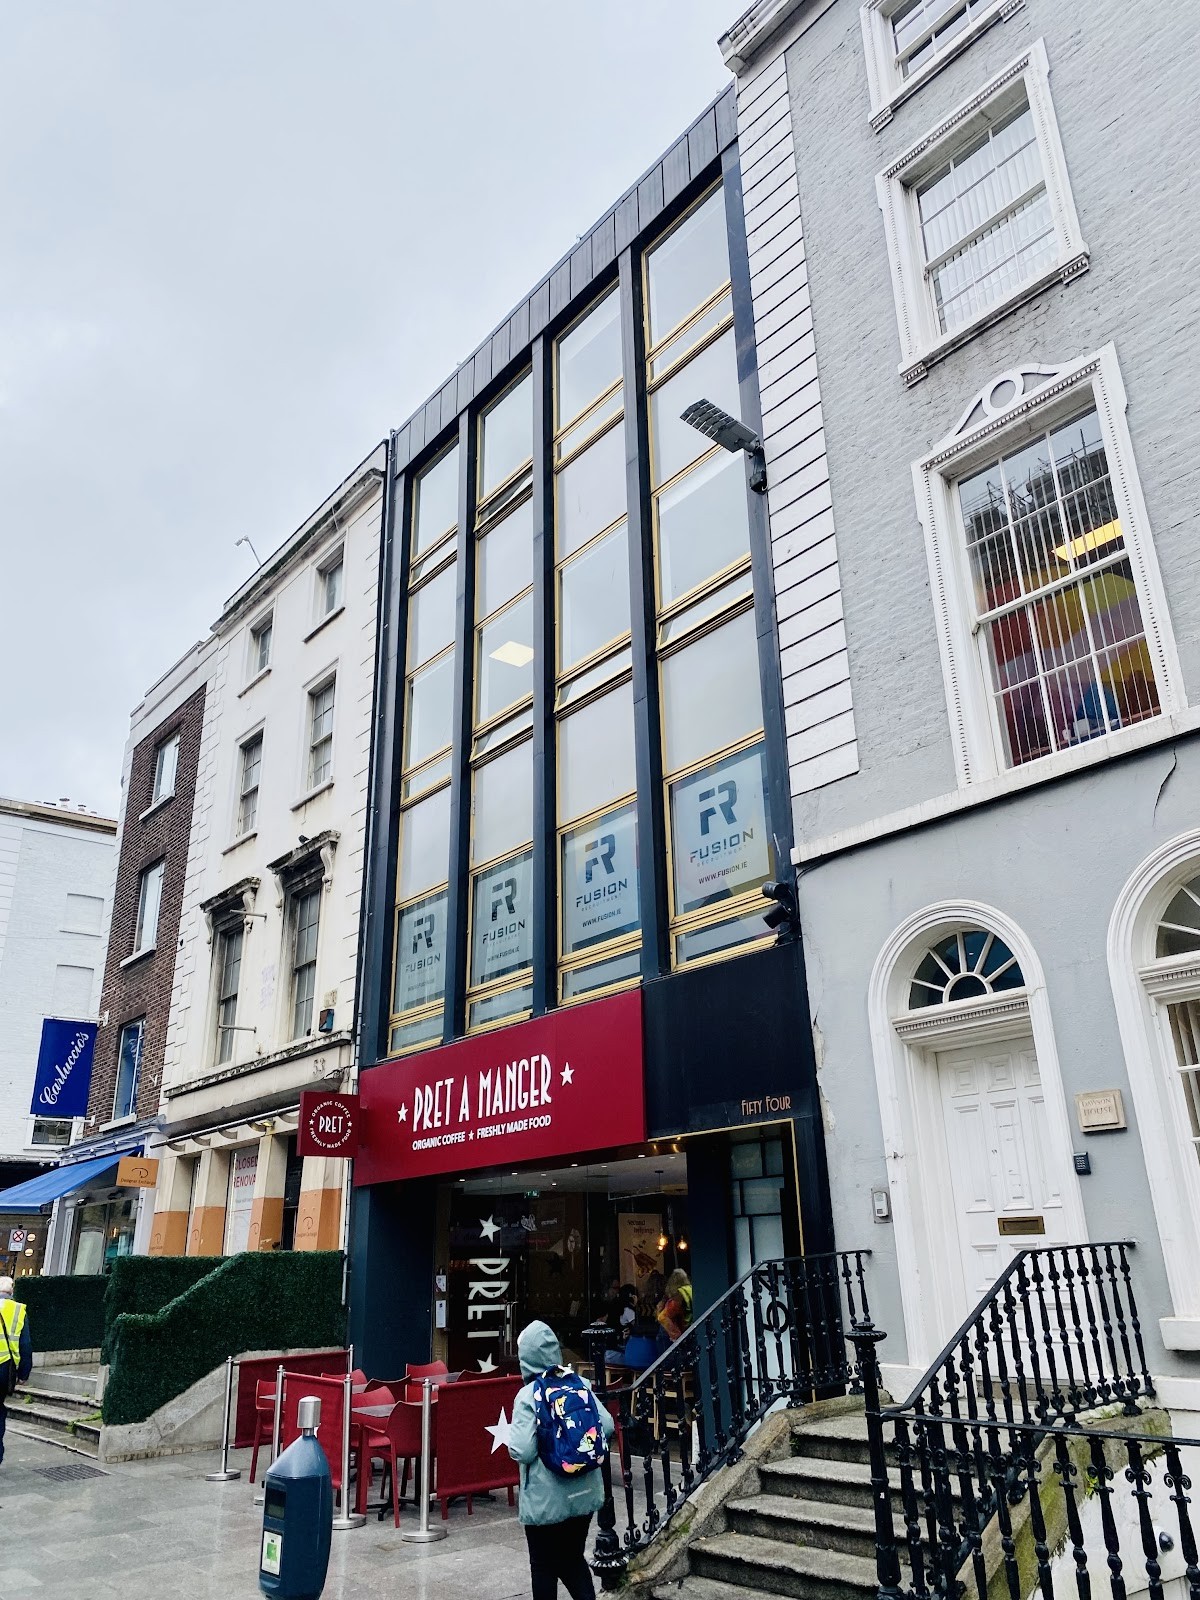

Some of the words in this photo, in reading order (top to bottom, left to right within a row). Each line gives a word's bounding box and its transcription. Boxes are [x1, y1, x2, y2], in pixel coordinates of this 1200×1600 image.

[690, 827, 754, 863] FUSION
[698, 861, 748, 884] WWW.FUSION.IE
[576, 878, 628, 908] FUSION
[582, 907, 622, 928] WWW.FUSION.IE
[482, 918, 526, 944] FUSION
[405, 953, 441, 972] FUSION
[39, 1031, 90, 1105] Carluccio's
[412, 1077, 455, 1132] PRET
[458, 1074, 470, 1123] A
[477, 1053, 552, 1119] MANGER
[311, 1100, 333, 1117] ORGANIC
[334, 1101, 351, 1118] COFFEE
[741, 1100, 763, 1116] FIFTY
[765, 1095, 791, 1112] FOUR
[318, 1115, 344, 1133] PRET
[412, 1136, 442, 1151] ORGANIC
[442, 1131, 466, 1146] COFFEE
[476, 1123, 508, 1139] FRESHLY
[506, 1119, 529, 1134] MADE
[528, 1114, 552, 1129] FOOD
[326, 1140, 342, 1149] MADE
[341, 1128, 352, 1143] FOOD
[466, 1257, 511, 1343] PRET
